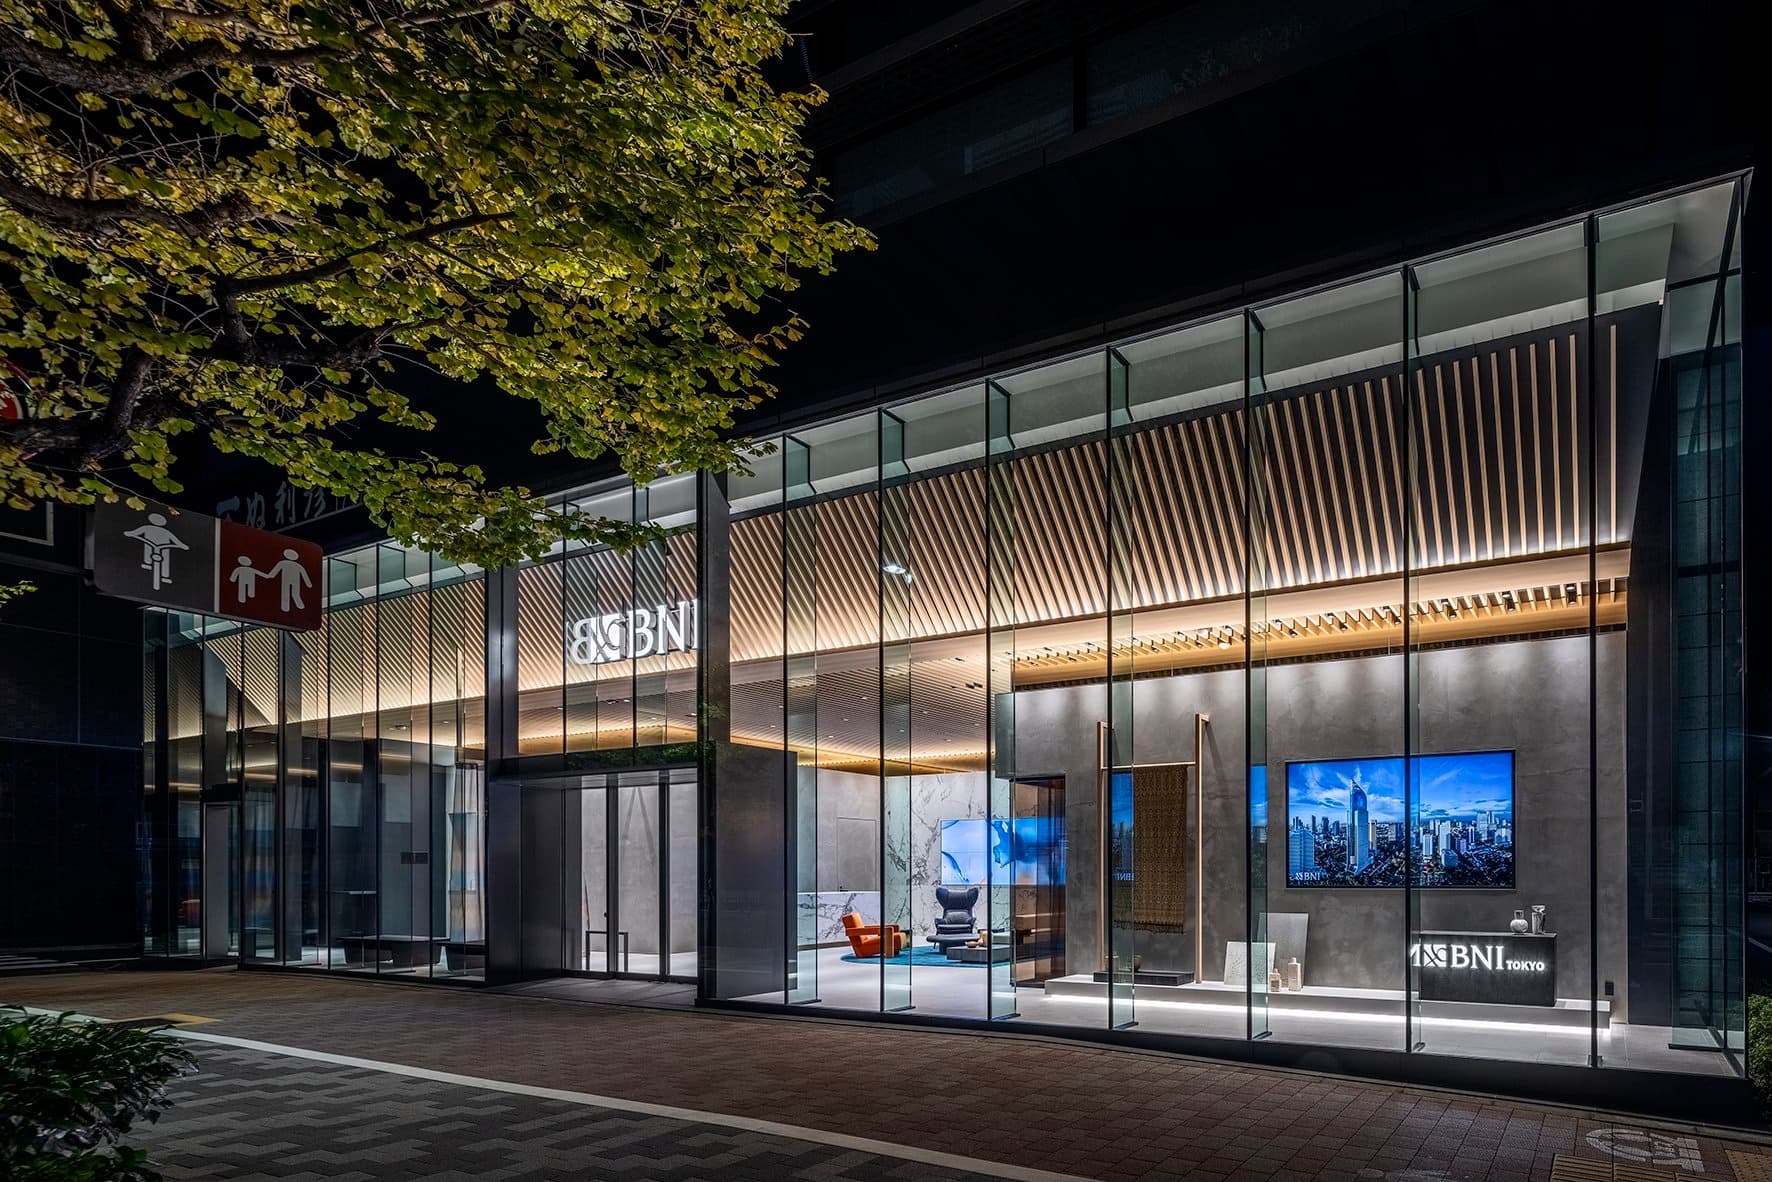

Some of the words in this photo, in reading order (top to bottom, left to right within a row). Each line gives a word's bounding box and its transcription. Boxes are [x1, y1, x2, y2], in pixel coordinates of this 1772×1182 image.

[1304, 872, 1320, 881] BNI
[1450, 943, 1505, 970] BNI
[1505, 960, 1545, 972] TOKYO
